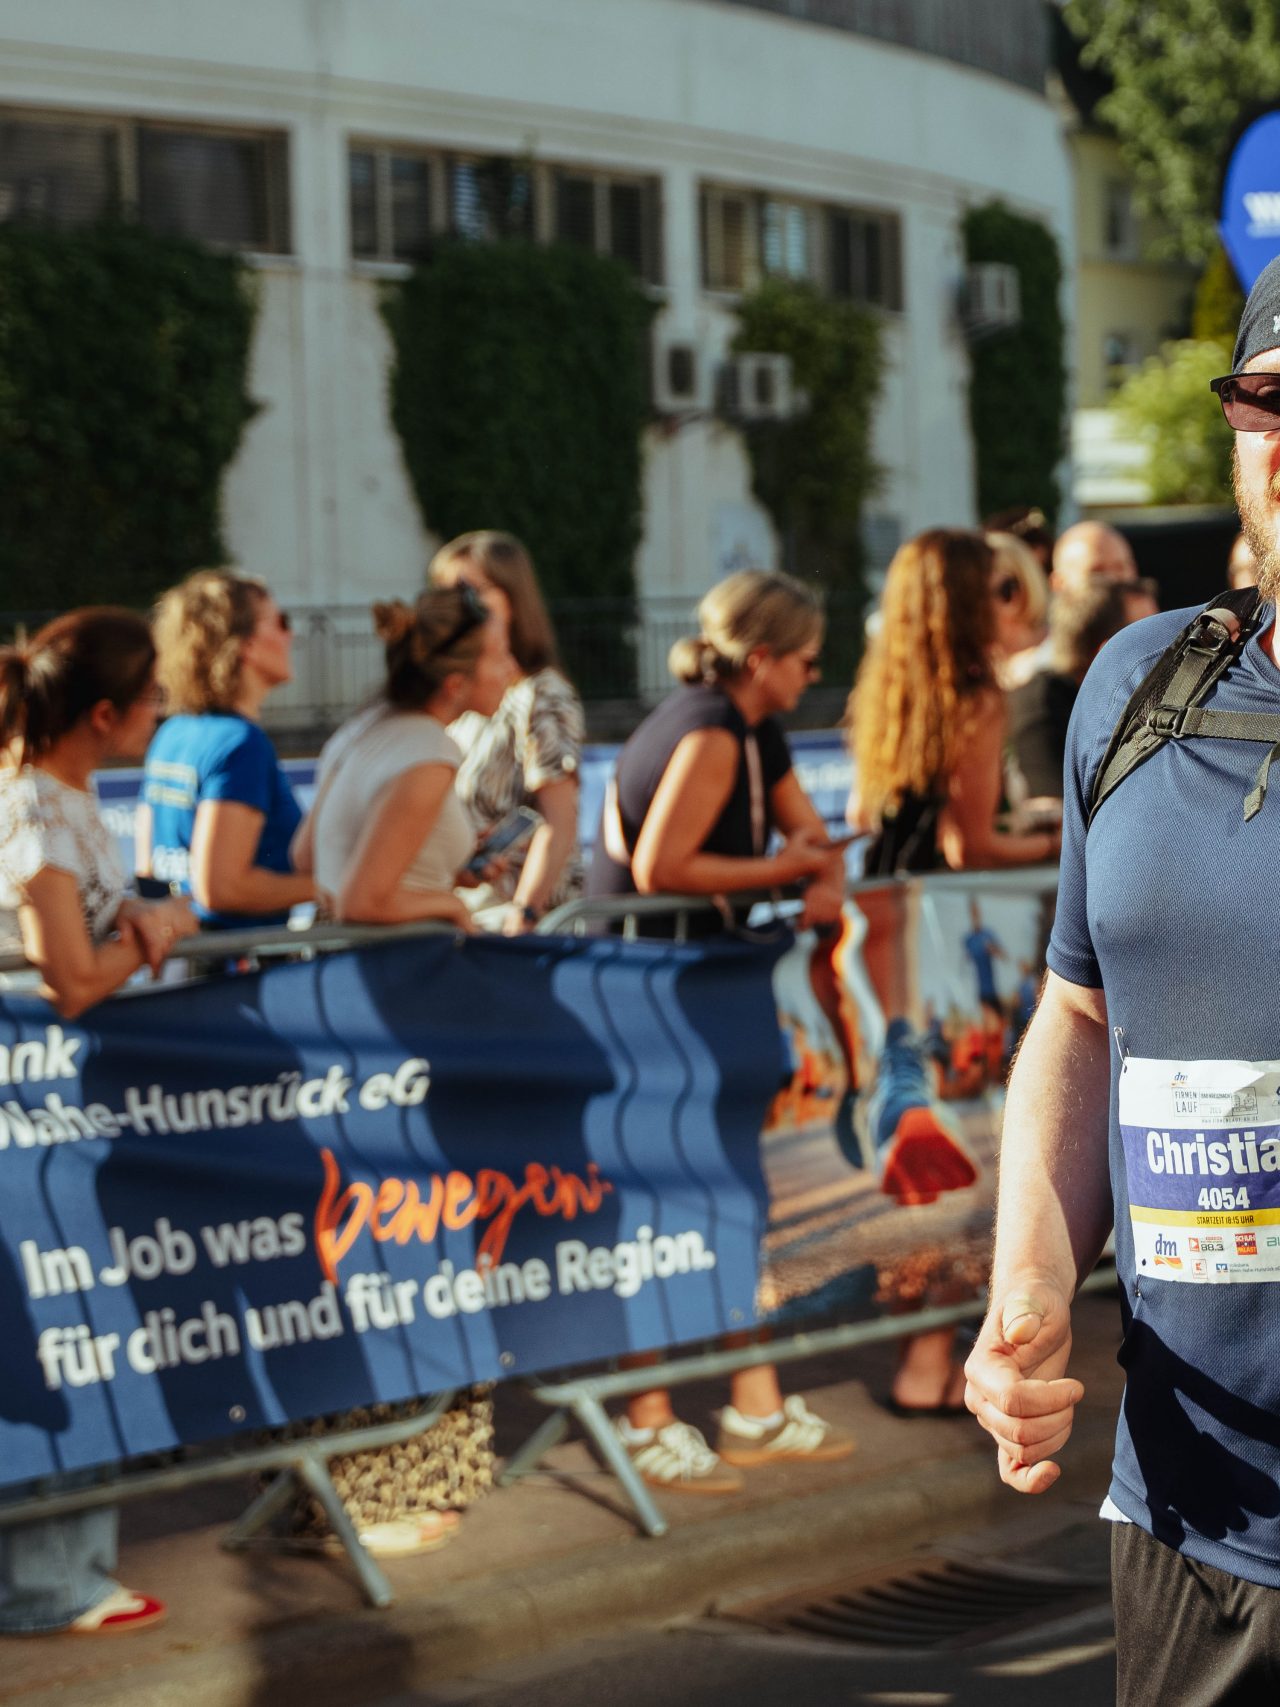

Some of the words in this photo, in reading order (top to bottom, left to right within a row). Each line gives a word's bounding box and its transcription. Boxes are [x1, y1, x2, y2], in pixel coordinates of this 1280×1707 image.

[0, 1024, 81, 1085] nk
[358, 1057, 431, 1110] eG
[1175, 1091, 1197, 1099] FIRMEN
[1176, 1101, 1198, 1113] LAUF
[1197, 1186, 1250, 1210] 4054
[1197, 1216, 1224, 1225] STARTZEIT
[1240, 1215, 1254, 1224] UHR
[20, 1239, 95, 1299] Im
[100, 1217, 197, 1287] Job
[201, 1212, 306, 1268] was
[1155, 1233, 1177, 1256] dm
[1201, 1243, 1224, 1252] 88.3
[38, 1323, 121, 1391] für
[127, 1300, 240, 1375] dich
[244, 1279, 344, 1351] und
[345, 1272, 419, 1333] für
[423, 1252, 551, 1320] deine
[555, 1224, 716, 1298] Region.
